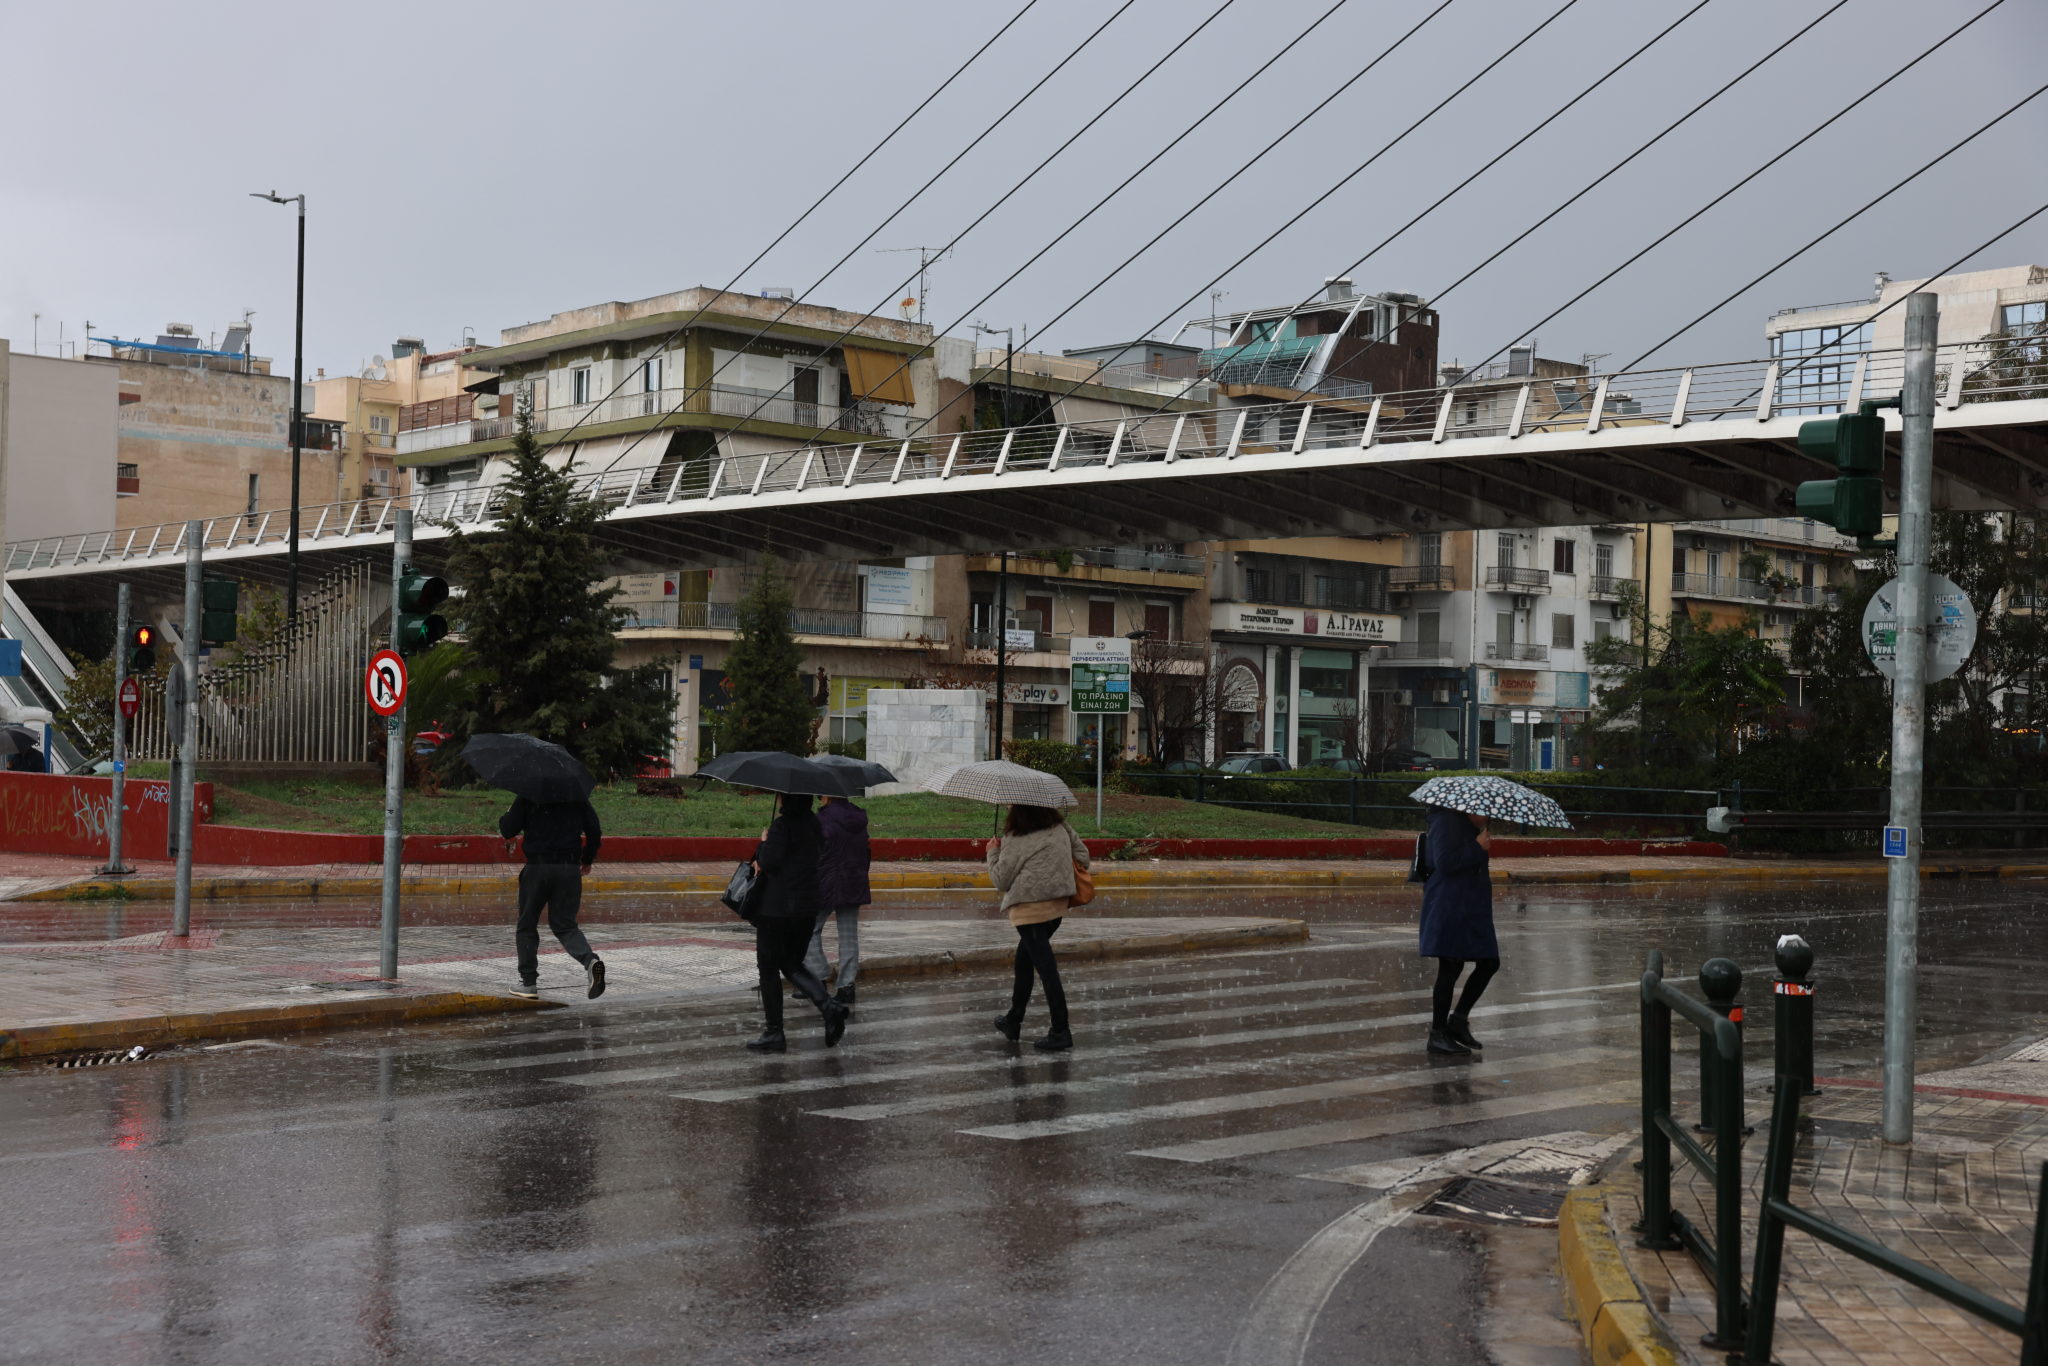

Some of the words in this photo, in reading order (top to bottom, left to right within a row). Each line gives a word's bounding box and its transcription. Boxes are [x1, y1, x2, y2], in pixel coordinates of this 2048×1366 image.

[1024, 685, 1047, 702] play
[1077, 692, 1087, 700] ΤΟ
[1089, 692, 1124, 700] ΠΡΑΣΙΝΟ
